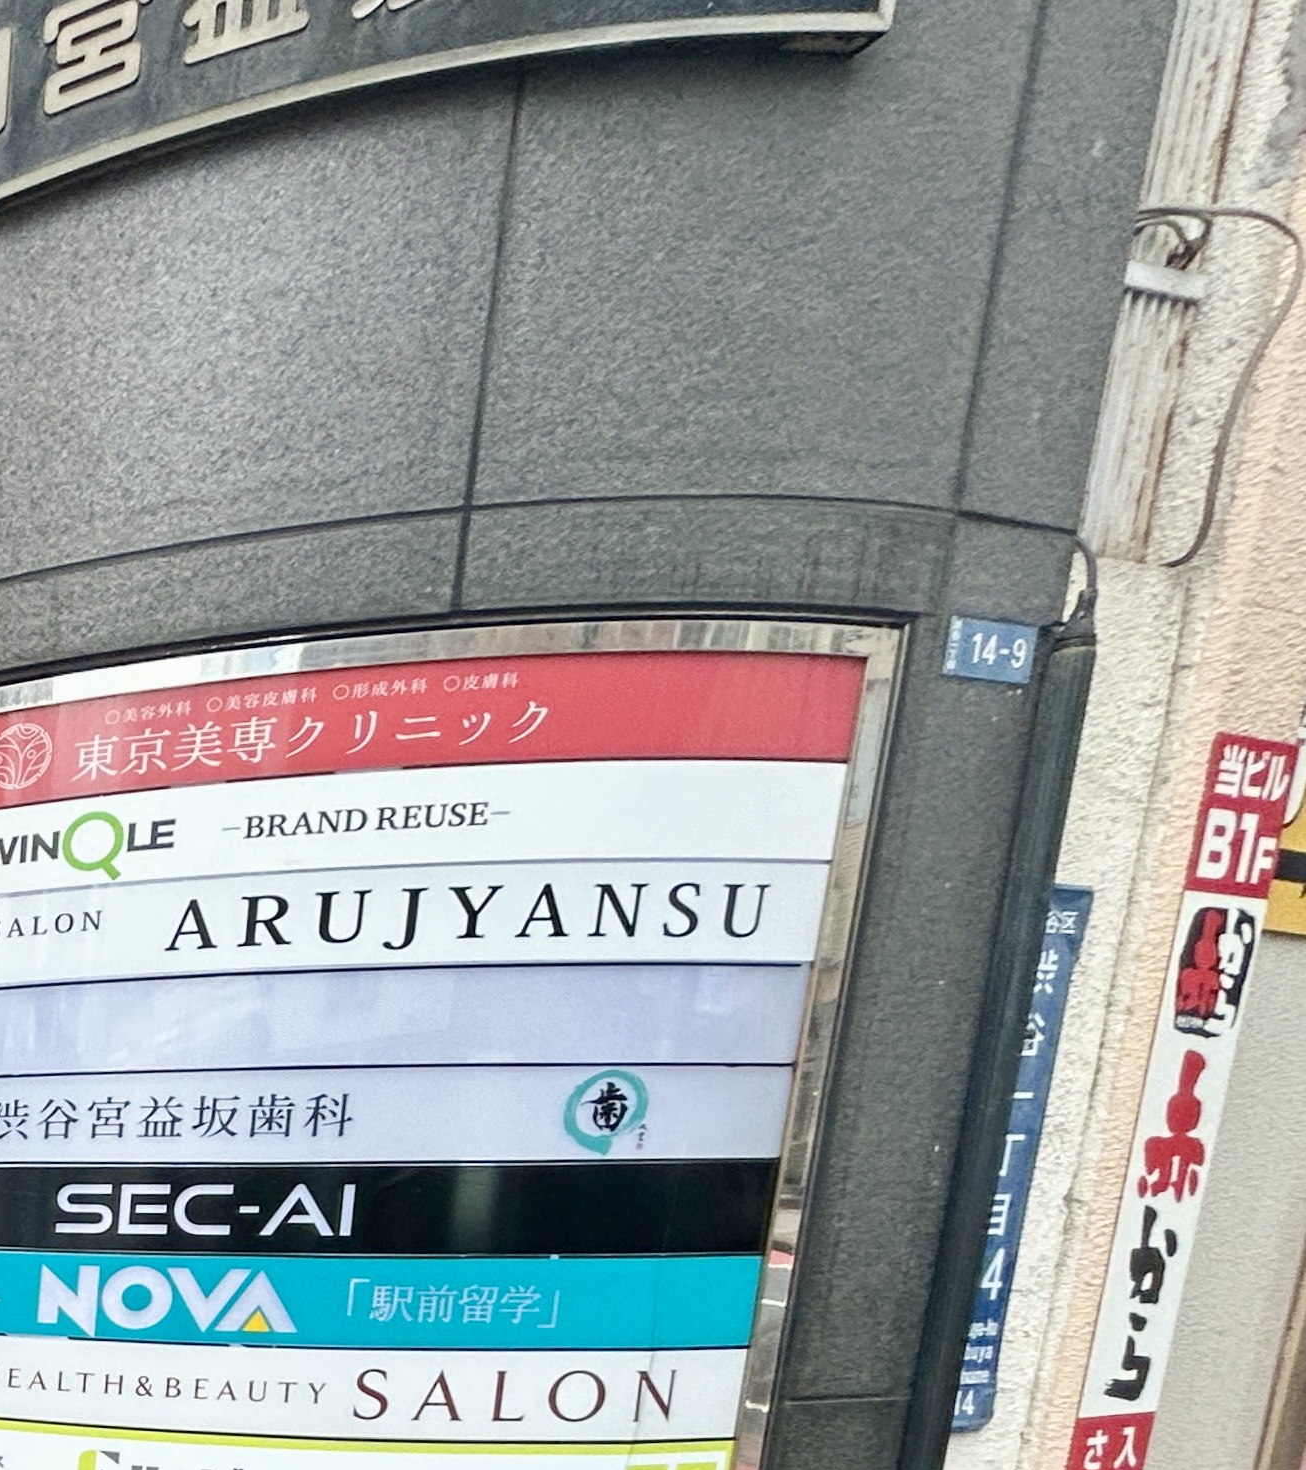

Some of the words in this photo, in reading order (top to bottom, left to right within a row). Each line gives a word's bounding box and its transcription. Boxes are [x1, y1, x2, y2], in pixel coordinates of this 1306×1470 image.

[970, 632, 1028, 670] 14-9
[70, 700, 551, 784] 東京美専クリニック
[1213, 743, 1290, 802] 当ビル
[1196, 806, 1278, 885] B1F
[165, 882, 774, 952] ARUJYANSU
[54, 1182, 357, 1238] SEC-AI
[37, 1263, 298, 1338] NOVA
[353, 1368, 678, 1424] SALON
